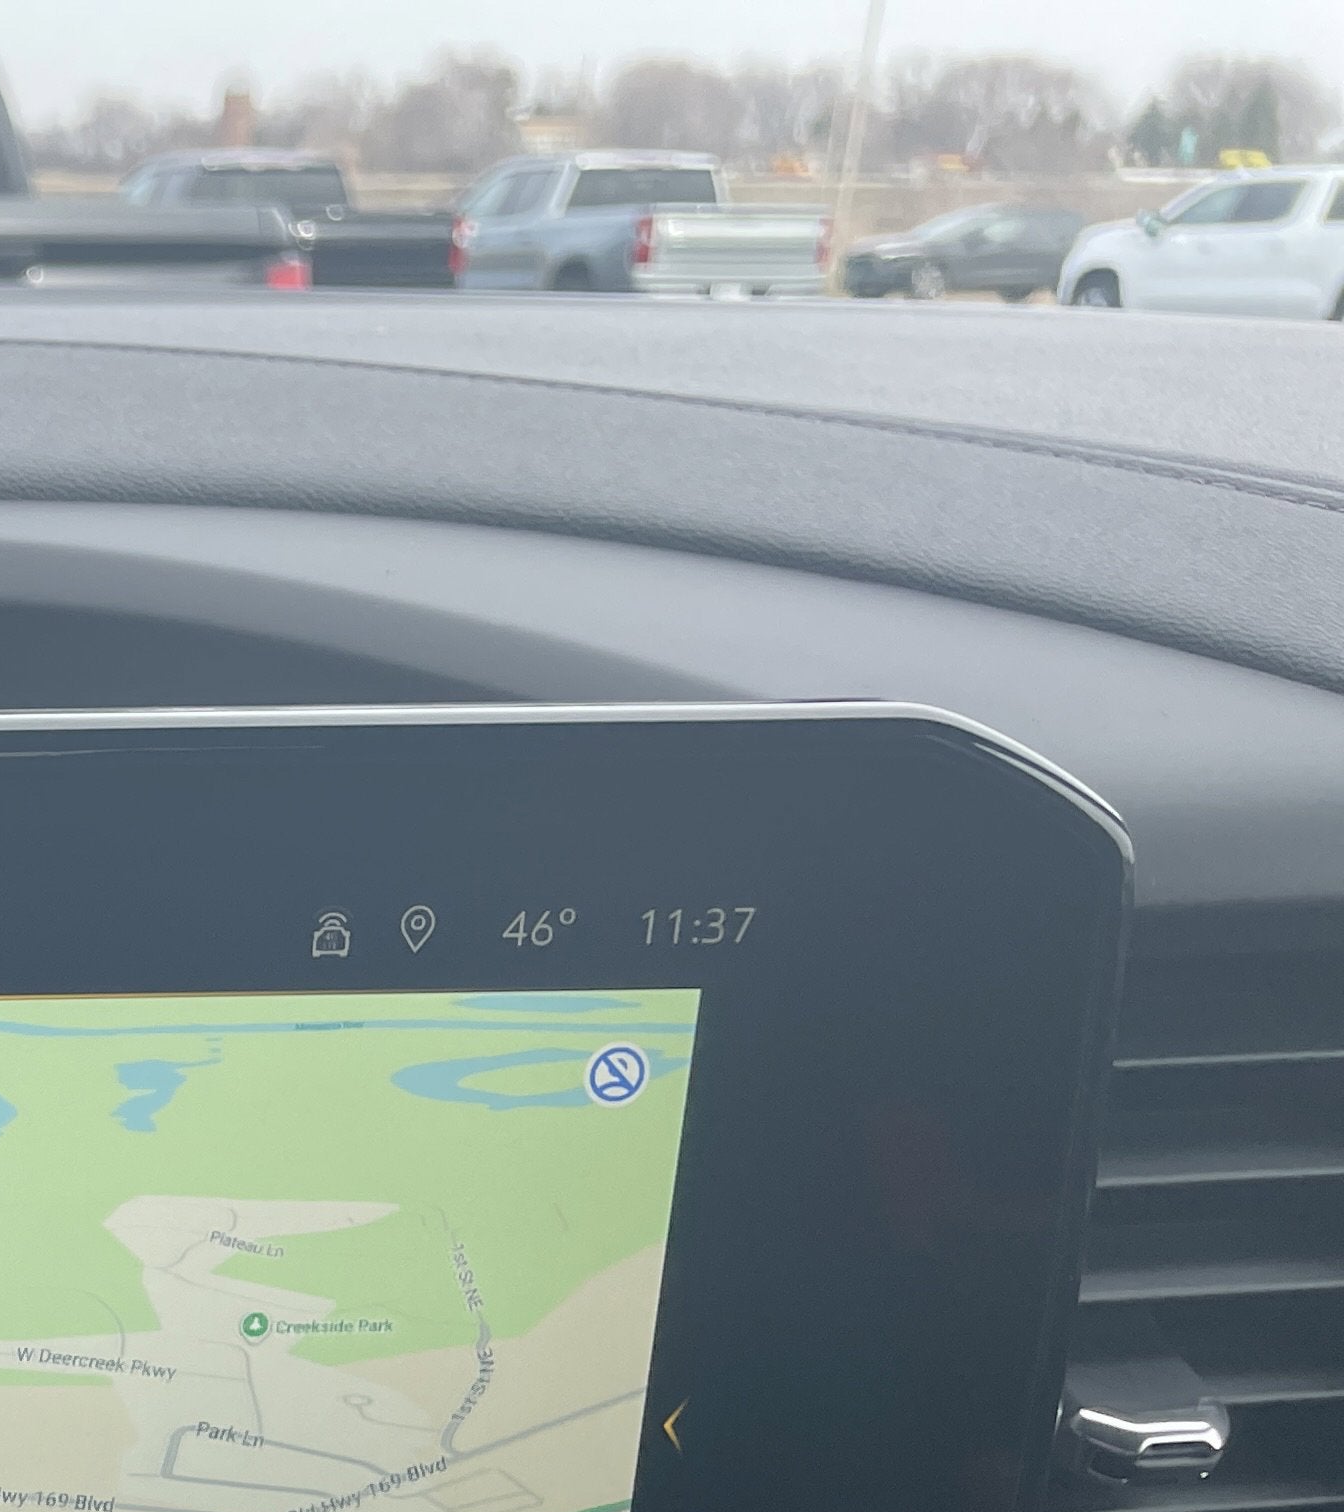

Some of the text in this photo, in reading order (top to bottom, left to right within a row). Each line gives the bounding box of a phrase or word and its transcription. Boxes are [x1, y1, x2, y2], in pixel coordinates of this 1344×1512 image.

[641, 906, 756, 945] 11:37
[210, 1230, 284, 1257] Plateau Ln
[276, 1319, 393, 1334] Creekside Park
[16, 1347, 177, 1384] W Deercreek Pkwy
[196, 1420, 265, 1448] Park Ln
[35, 1490, 69, 1508] 169
[74, 1494, 115, 1512] Blvd
